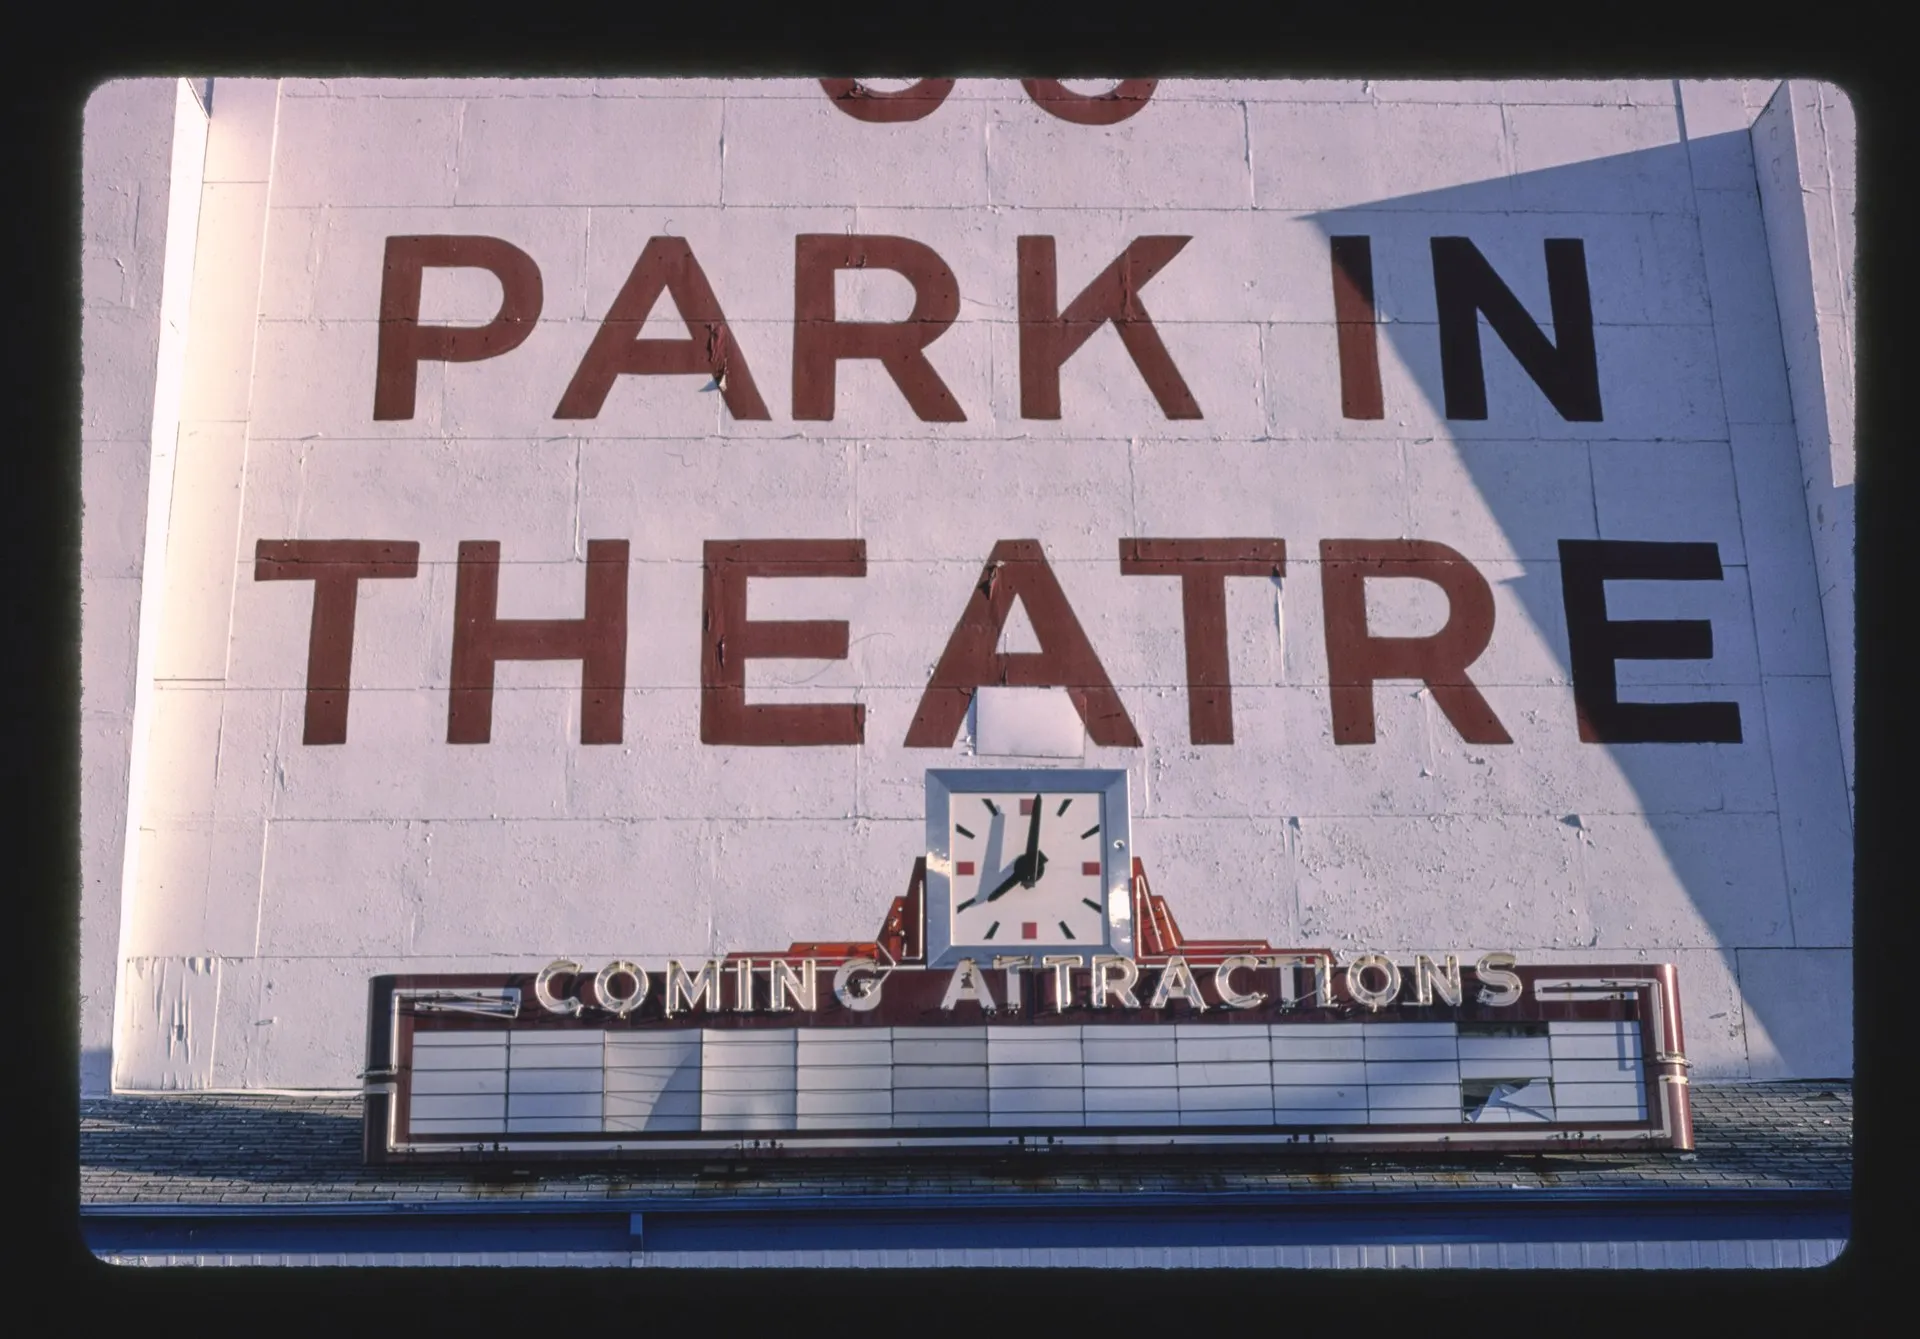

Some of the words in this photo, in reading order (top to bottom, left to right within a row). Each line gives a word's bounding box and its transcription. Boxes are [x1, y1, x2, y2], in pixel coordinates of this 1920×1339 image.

[373, 234, 1203, 422] PARK
[1331, 236, 1602, 422] IN
[255, 538, 1742, 747] THEATRE
[534, 957, 883, 1014] COMING
[940, 954, 1523, 1010] ATTRACTIONS
